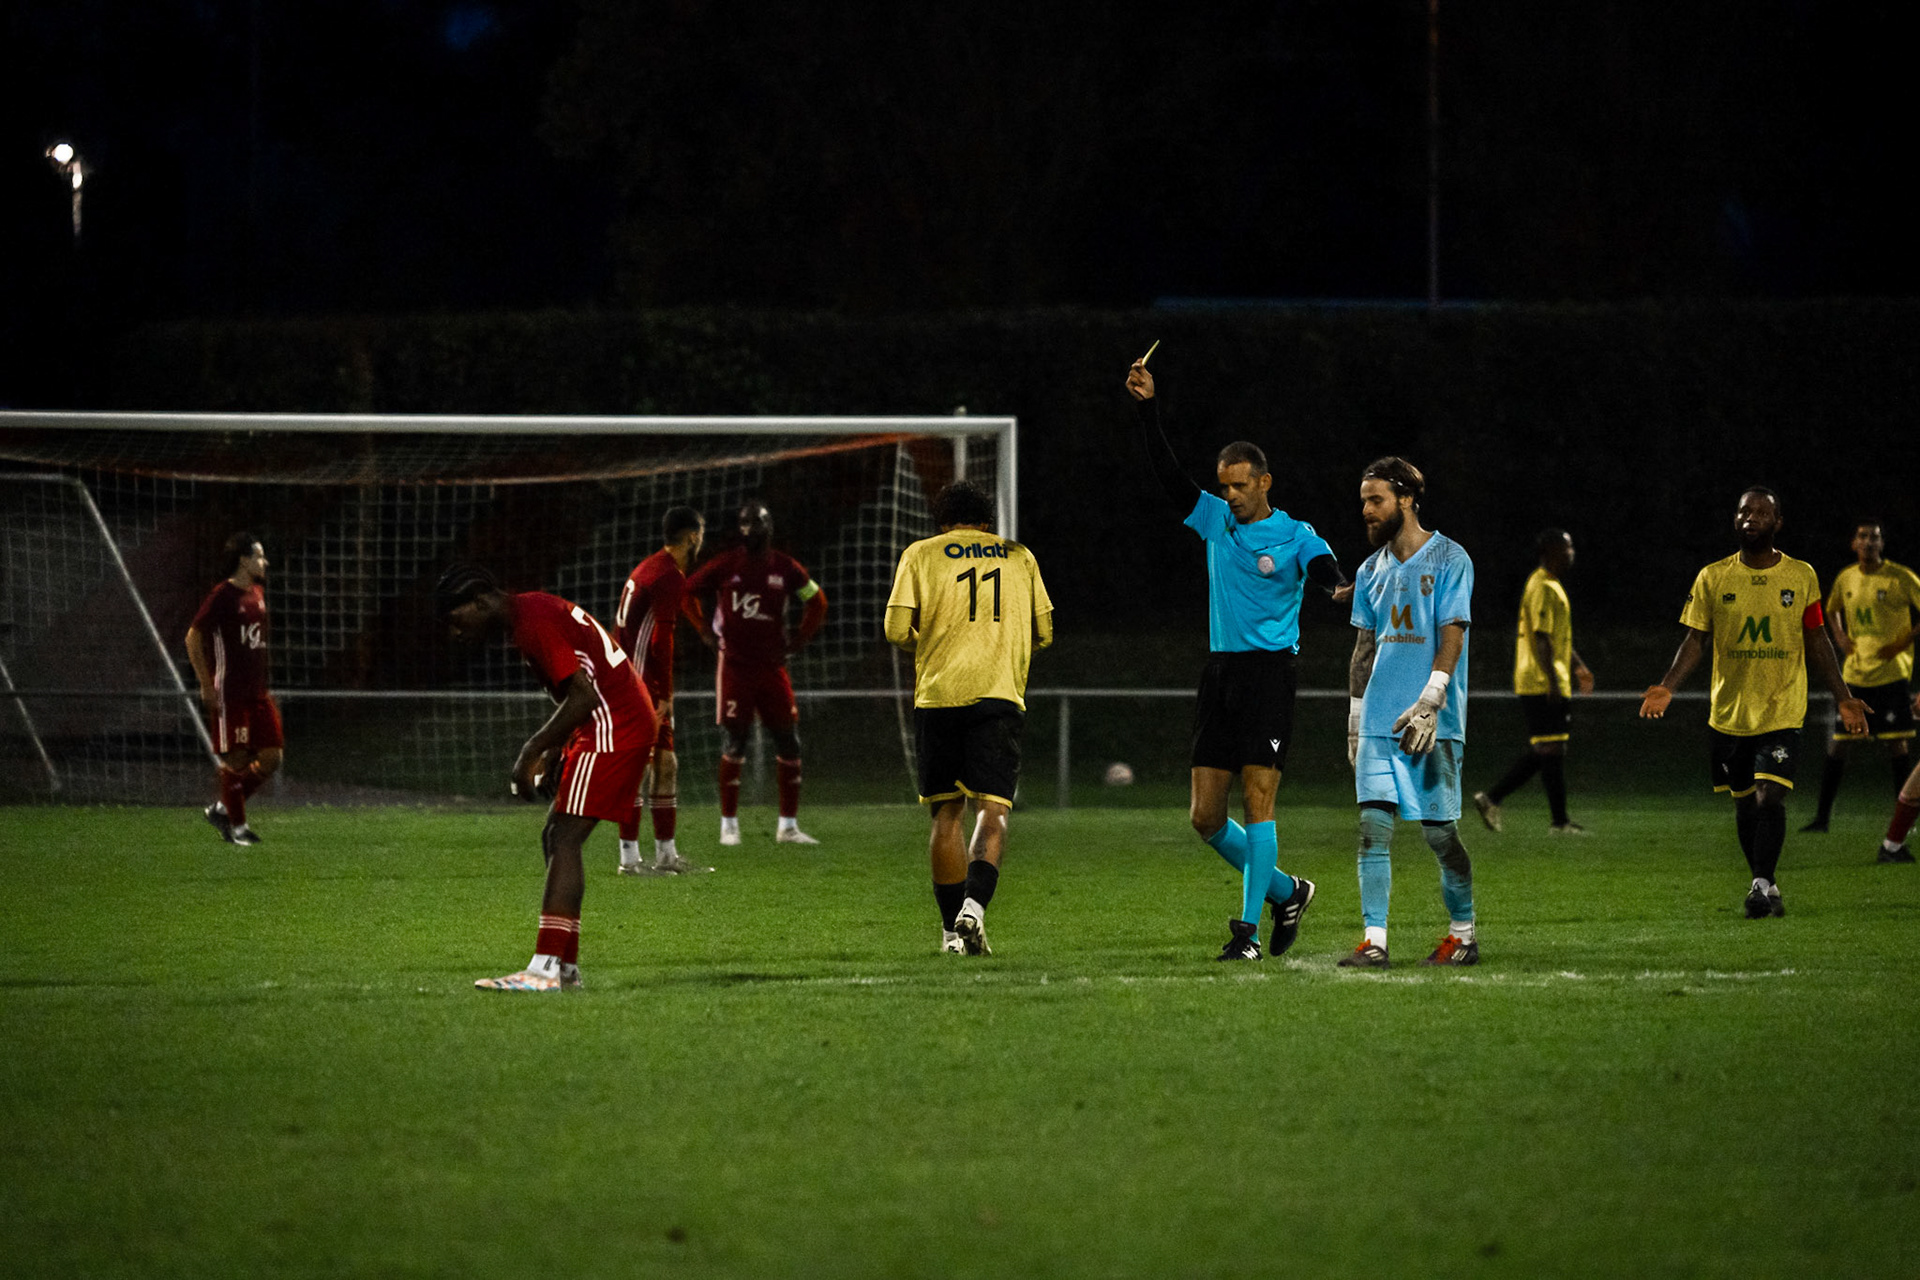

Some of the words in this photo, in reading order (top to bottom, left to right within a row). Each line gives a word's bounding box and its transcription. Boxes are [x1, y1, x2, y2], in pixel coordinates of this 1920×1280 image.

[944, 542, 1008, 559] Orllati
[956, 566, 1001, 622] 11
[1856, 607, 1873, 625] M
[1737, 615, 1773, 643] M
[725, 700, 738, 718] 2
[234, 725, 249, 744] 18
